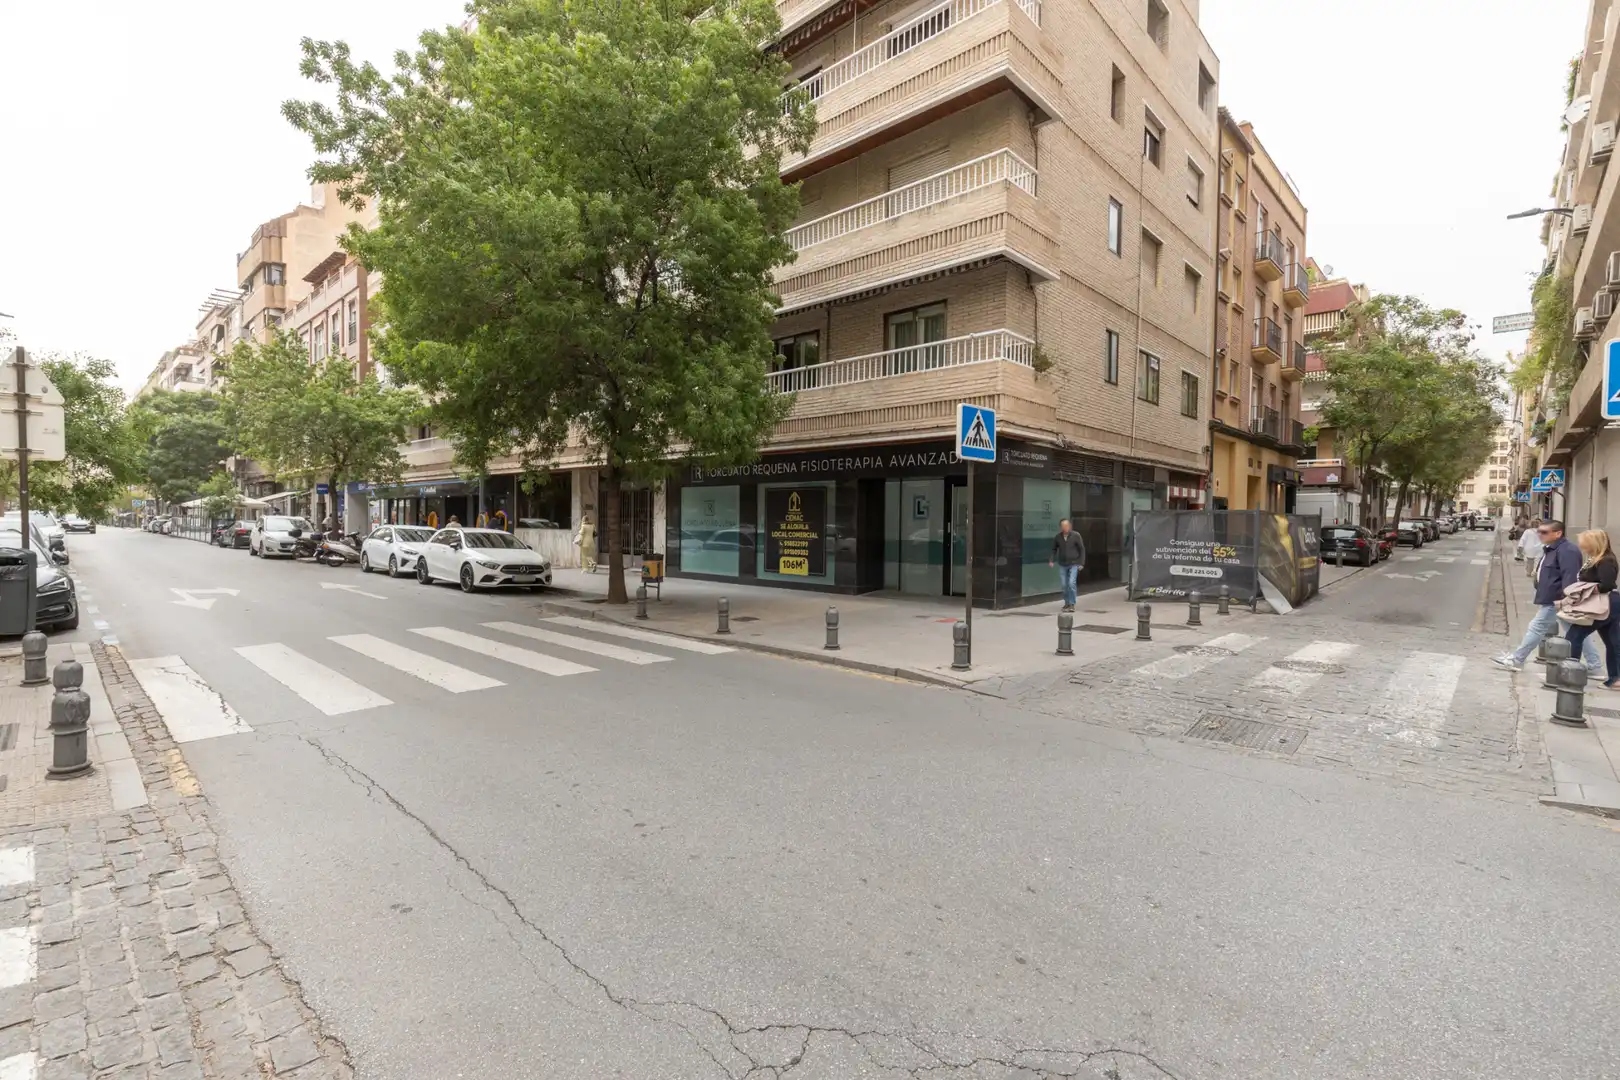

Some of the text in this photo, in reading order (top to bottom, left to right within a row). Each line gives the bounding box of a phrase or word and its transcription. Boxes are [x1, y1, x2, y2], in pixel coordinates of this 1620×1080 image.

[752, 462, 798, 476] REQUENA
[801, 456, 884, 472] FISIOTERAPIA
[889, 451, 964, 468] AVANZAD
[788, 531, 819, 539] COMERCIAL
[1169, 539, 1205, 548] Consigue
[1156, 546, 1198, 554] subvención
[1212, 546, 1237, 558] 55%
